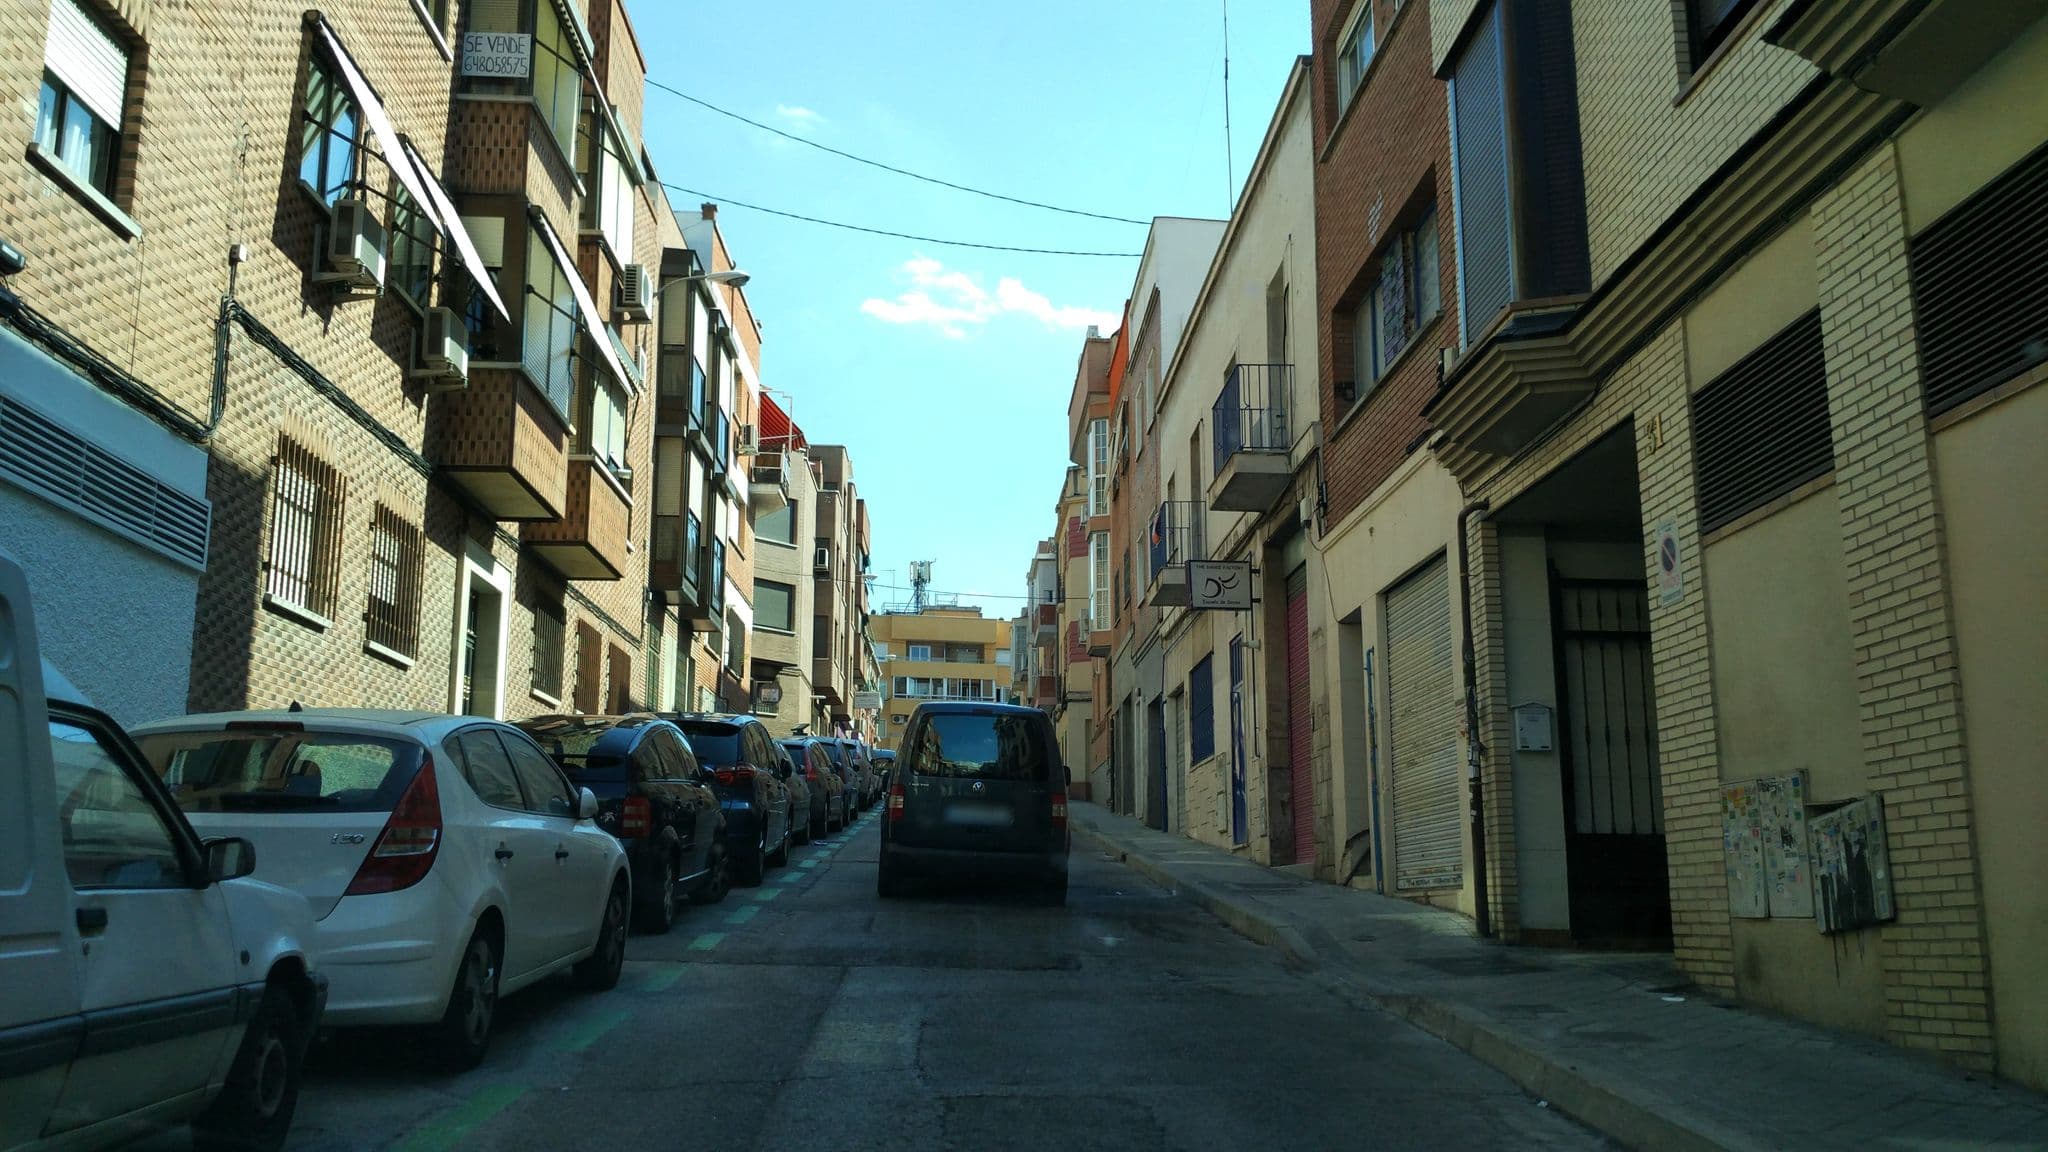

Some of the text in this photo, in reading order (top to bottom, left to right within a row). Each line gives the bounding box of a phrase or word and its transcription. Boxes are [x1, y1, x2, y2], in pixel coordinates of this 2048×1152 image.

[465, 35, 526, 54] SE VENDE
[464, 55, 528, 76] 648058575
